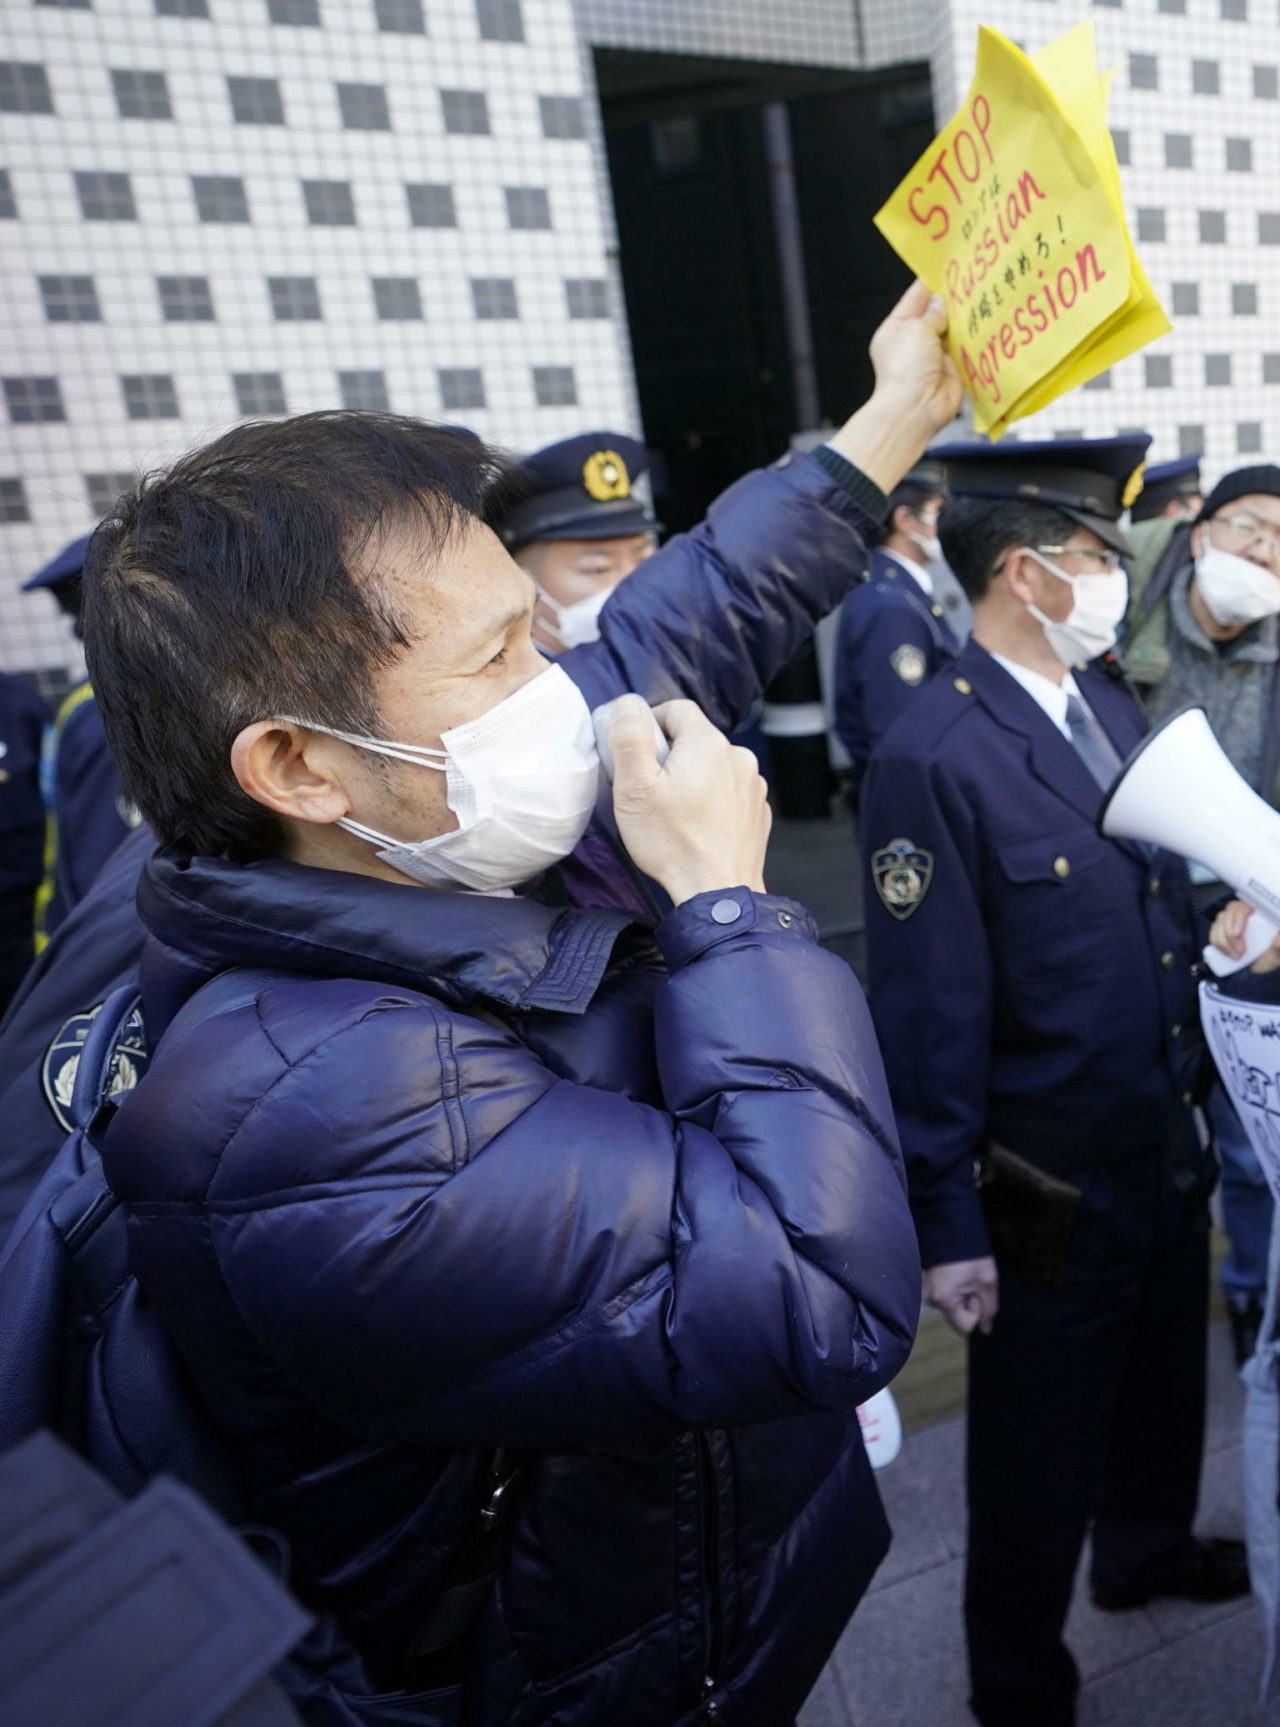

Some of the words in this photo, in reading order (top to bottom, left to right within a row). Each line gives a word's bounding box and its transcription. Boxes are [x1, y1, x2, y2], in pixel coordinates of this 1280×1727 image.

[907, 94, 995, 241] STOP
[944, 170, 1046, 311] Russian
[960, 242, 1107, 404] Agression
